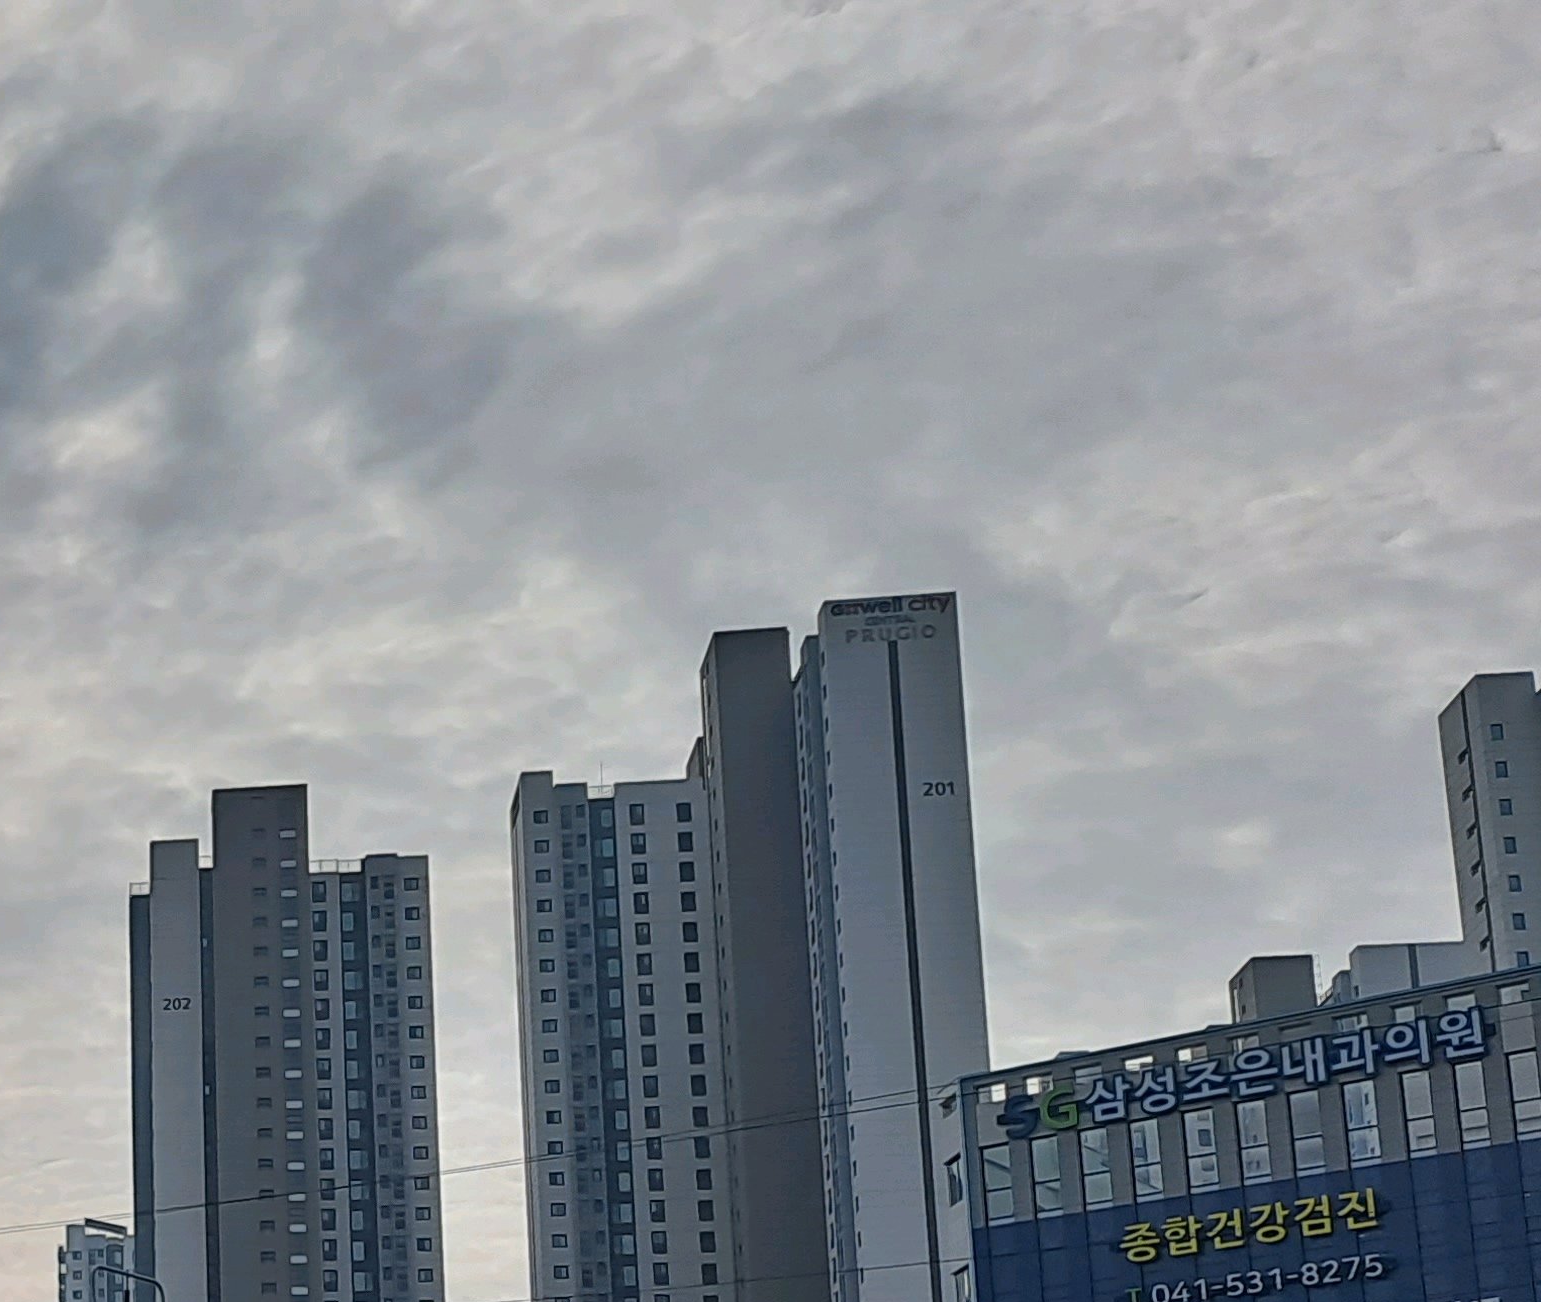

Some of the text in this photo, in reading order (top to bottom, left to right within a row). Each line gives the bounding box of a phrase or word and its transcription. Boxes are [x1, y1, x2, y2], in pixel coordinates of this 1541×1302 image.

[845, 624, 937, 643] PRUGIO
[922, 781, 956, 798] 201
[162, 997, 192, 1012] 202
[1085, 1007, 1487, 1122] 삼성조은내과의원
[1119, 1187, 1379, 1263] 종합건강검진
